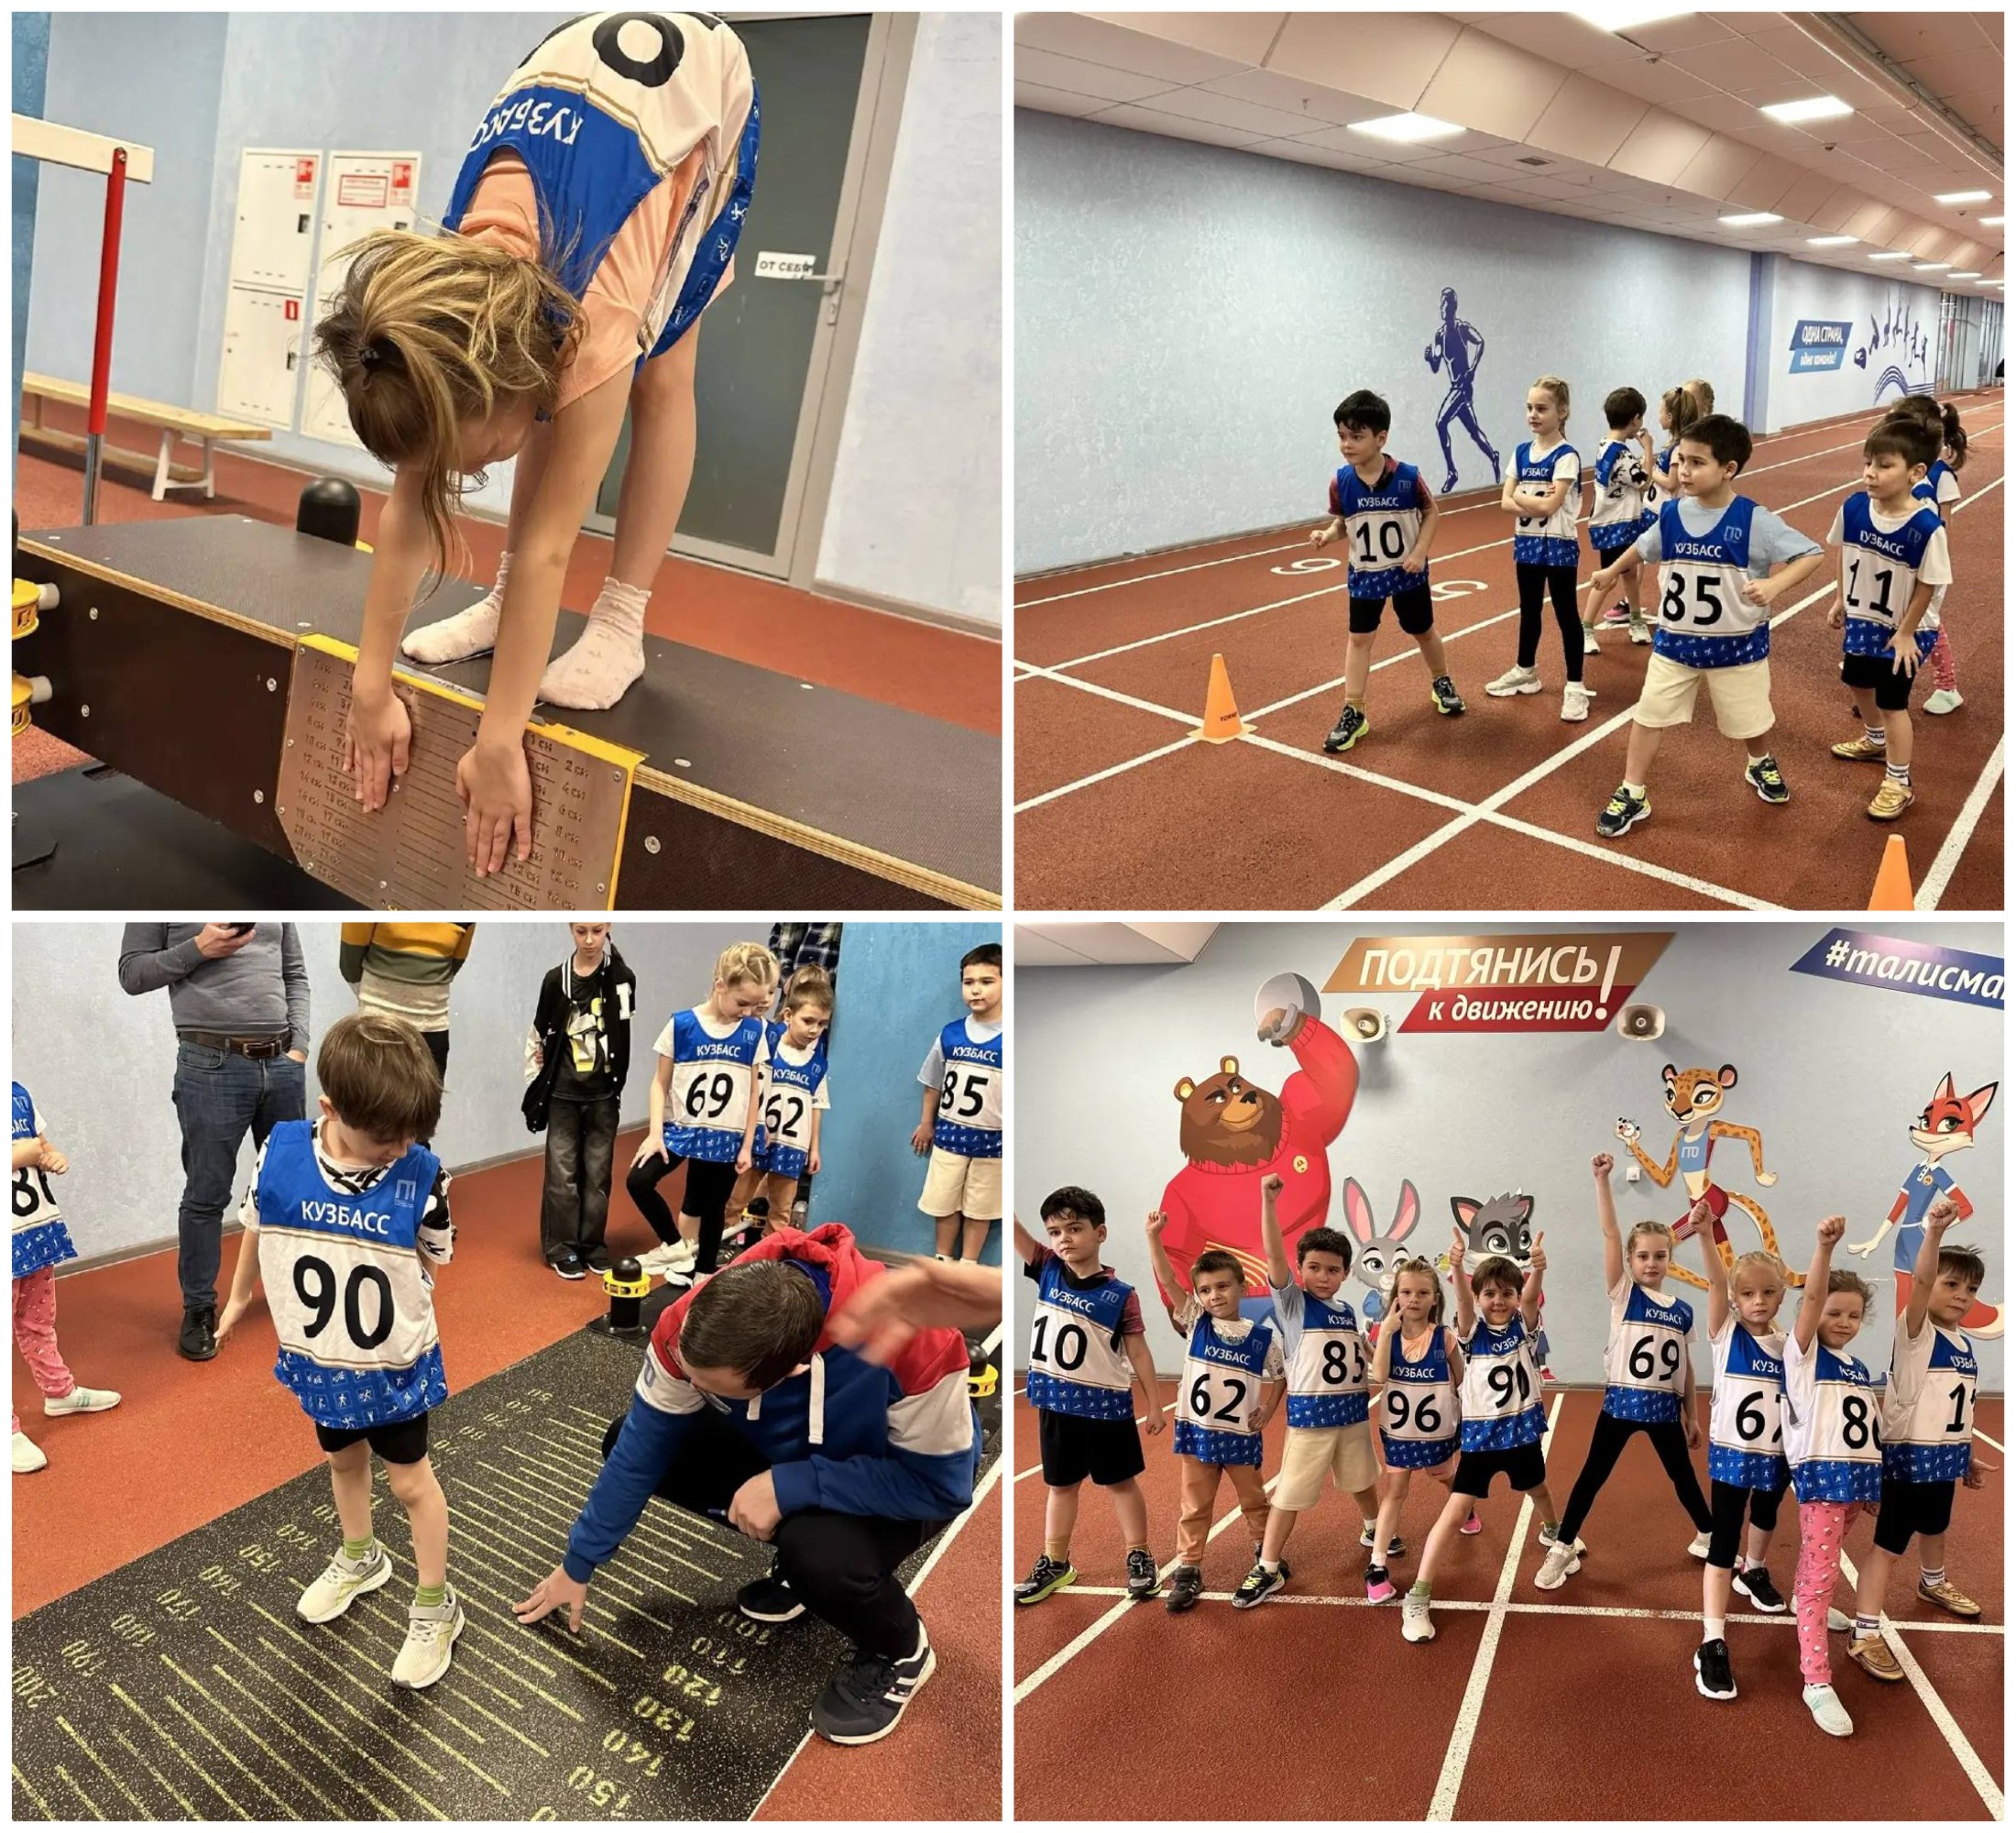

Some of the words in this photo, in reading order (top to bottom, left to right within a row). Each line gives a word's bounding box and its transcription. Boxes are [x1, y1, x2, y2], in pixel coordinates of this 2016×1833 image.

[759, 260, 775, 271] ОТ
[1802, 325, 1820, 346] ОДНА
[1357, 497, 1399, 508] КУЗБАСС
[1356, 521, 1405, 562] 10
[1675, 543, 1722, 557] КУЗБАСС
[1663, 572, 1722, 625] 85
[1846, 558, 1894, 619] 11
[1824, 939, 2004, 1001] #талисма
[1428, 1001, 1443, 1020] к
[696, 1044, 741, 1058] КУЗБАСС
[952, 1046, 998, 1063] КУЗБАСС
[685, 1072, 733, 1118] 69
[772, 1069, 810, 1086] КУЗБАСС
[941, 1070, 989, 1117] 85
[765, 1093, 804, 1137] 62
[301, 1201, 390, 1235] КУЗБАСС
[293, 1255, 395, 1350] 90
[1048, 1287, 1095, 1313] КУЗБАСС
[1031, 1315, 1088, 1371] 10
[1204, 1344, 1251, 1366] КУЗБАСС
[1321, 1340, 1365, 1384] 85
[1629, 1334, 1680, 1382] 69
[1392, 1366, 1435, 1378] КУЗБАСС
[1190, 1373, 1246, 1423] 62
[1387, 1389, 1441, 1432] 96
[1945, 1382, 1977, 1432] 1
[239, 1543, 282, 1572] 150
[718, 1611, 771, 1645] 100
[691, 1636, 747, 1674] 110
[663, 1664, 722, 1707] 120
[634, 1696, 696, 1741] 130
[602, 1729, 664, 1777] 140
[568, 1765, 631, 1818] 150
